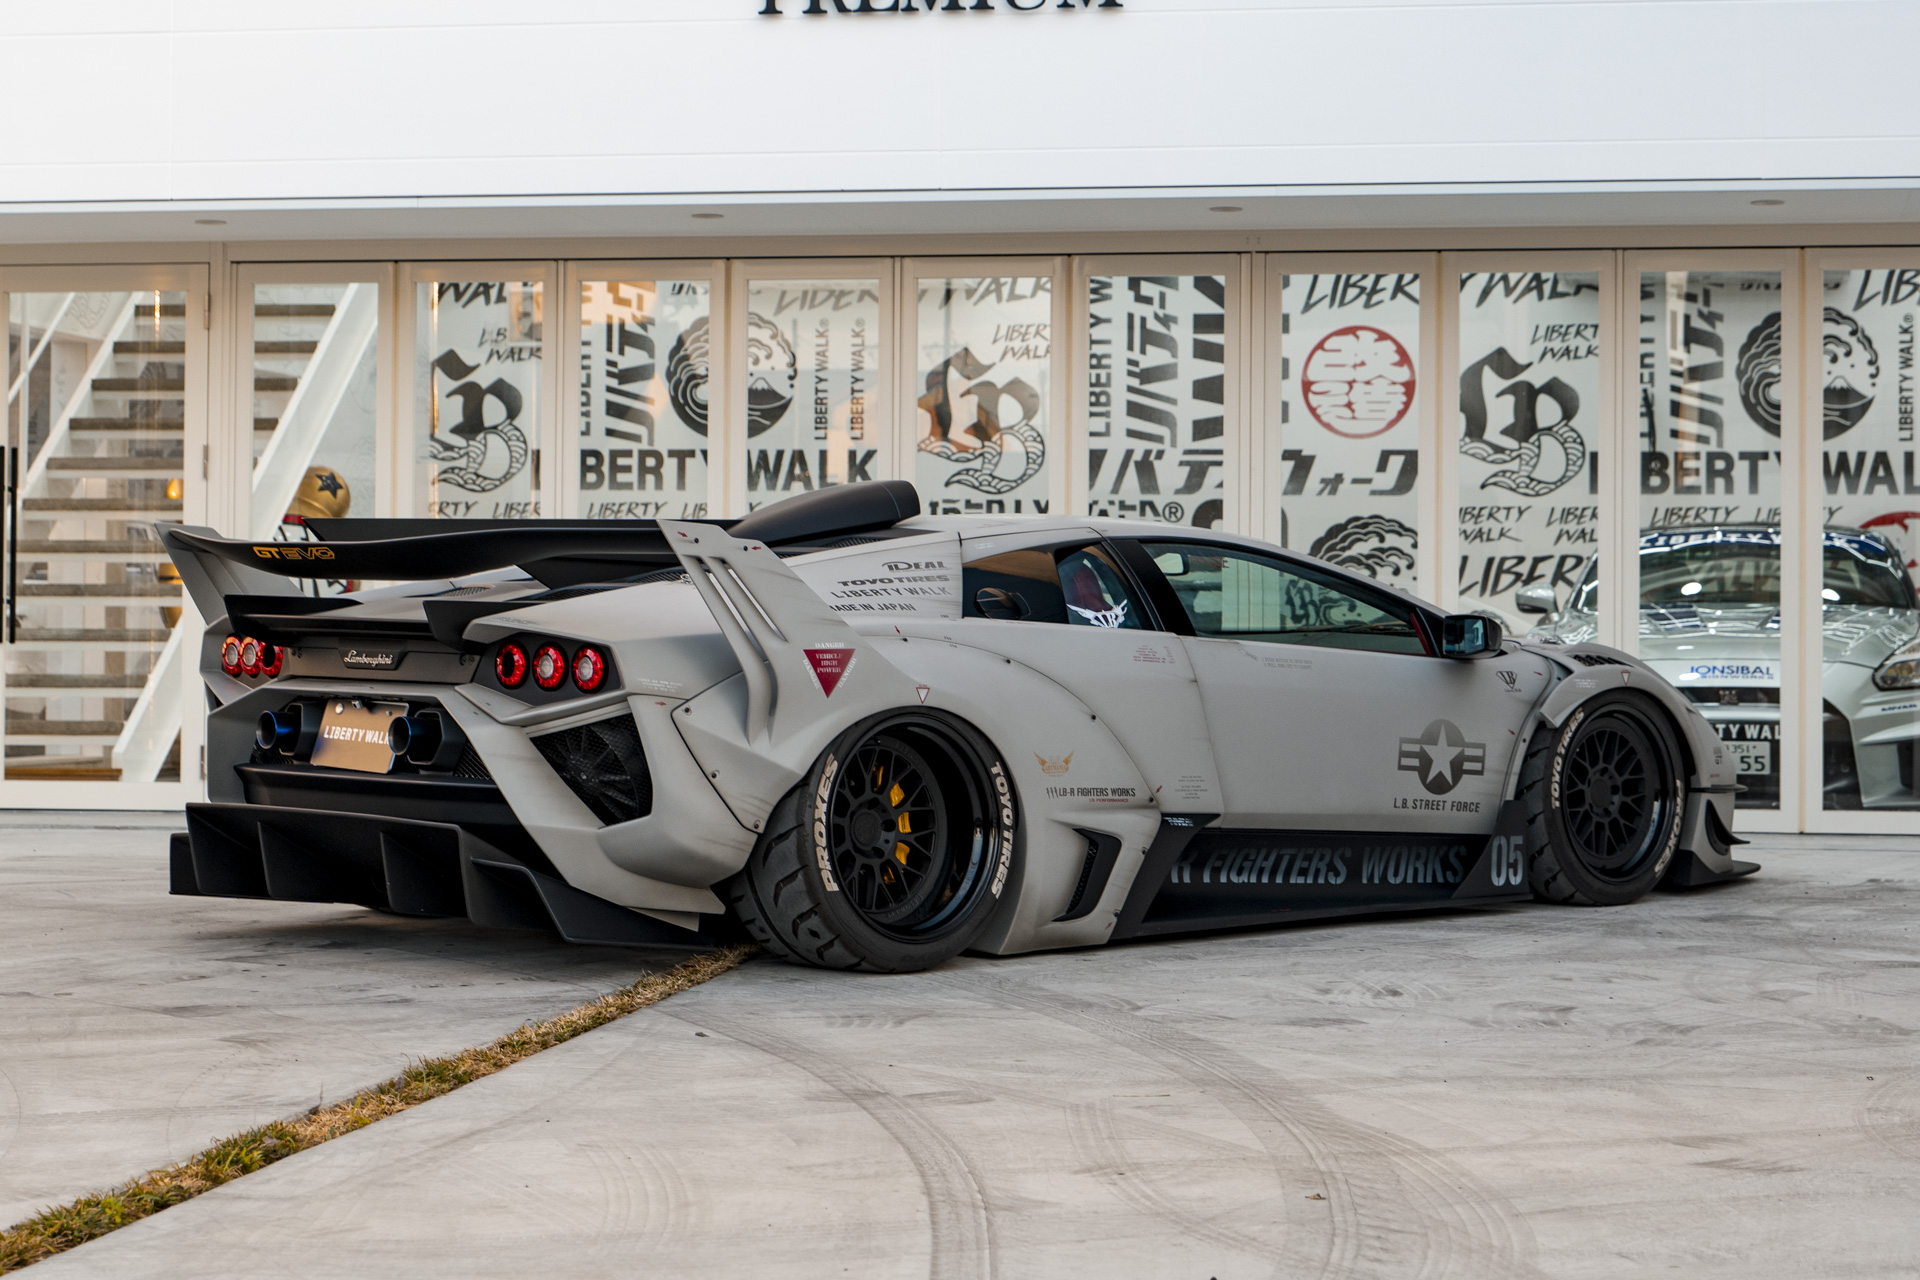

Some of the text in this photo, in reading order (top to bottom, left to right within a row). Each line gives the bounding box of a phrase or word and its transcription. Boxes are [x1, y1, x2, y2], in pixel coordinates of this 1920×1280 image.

[991, 323, 1050, 345] LIBER
[1089, 311, 1113, 437] LIBERTY
[814, 375, 829, 441] LIBERTY
[851, 375, 865, 441] LIBERTY
[1898, 373, 1914, 442] LIBERTY
[580, 449, 708, 491] BERT
[1641, 451, 1781, 494] BERT
[587, 501, 668, 519] LIBERTY
[1650, 506, 1740, 527] LIBERTY
[252, 546, 280, 559] GT
[882, 561, 947, 571] IDEAL
[830, 586, 953, 599] LIBERTY WALK
[860, 602, 876, 611] IN
[877, 602, 917, 612] JAPAN
[343, 650, 393, 667] Lamborghini
[323, 725, 367, 743] LIBERTY
[1551, 707, 1585, 809] TOYO TIRES
[1077, 787, 1109, 797] FIGHTERS
[1110, 787, 1136, 797] WORKS
[1411, 798, 1448, 811] STREET
[1450, 801, 1481, 812] FORCE
[813, 753, 840, 892] PROXES
[990, 761, 1013, 899] TOYO TIRES
[1202, 845, 1352, 885] FIGHTERS
[1361, 845, 1468, 884] WORKS
[1490, 835, 1524, 887] 05
